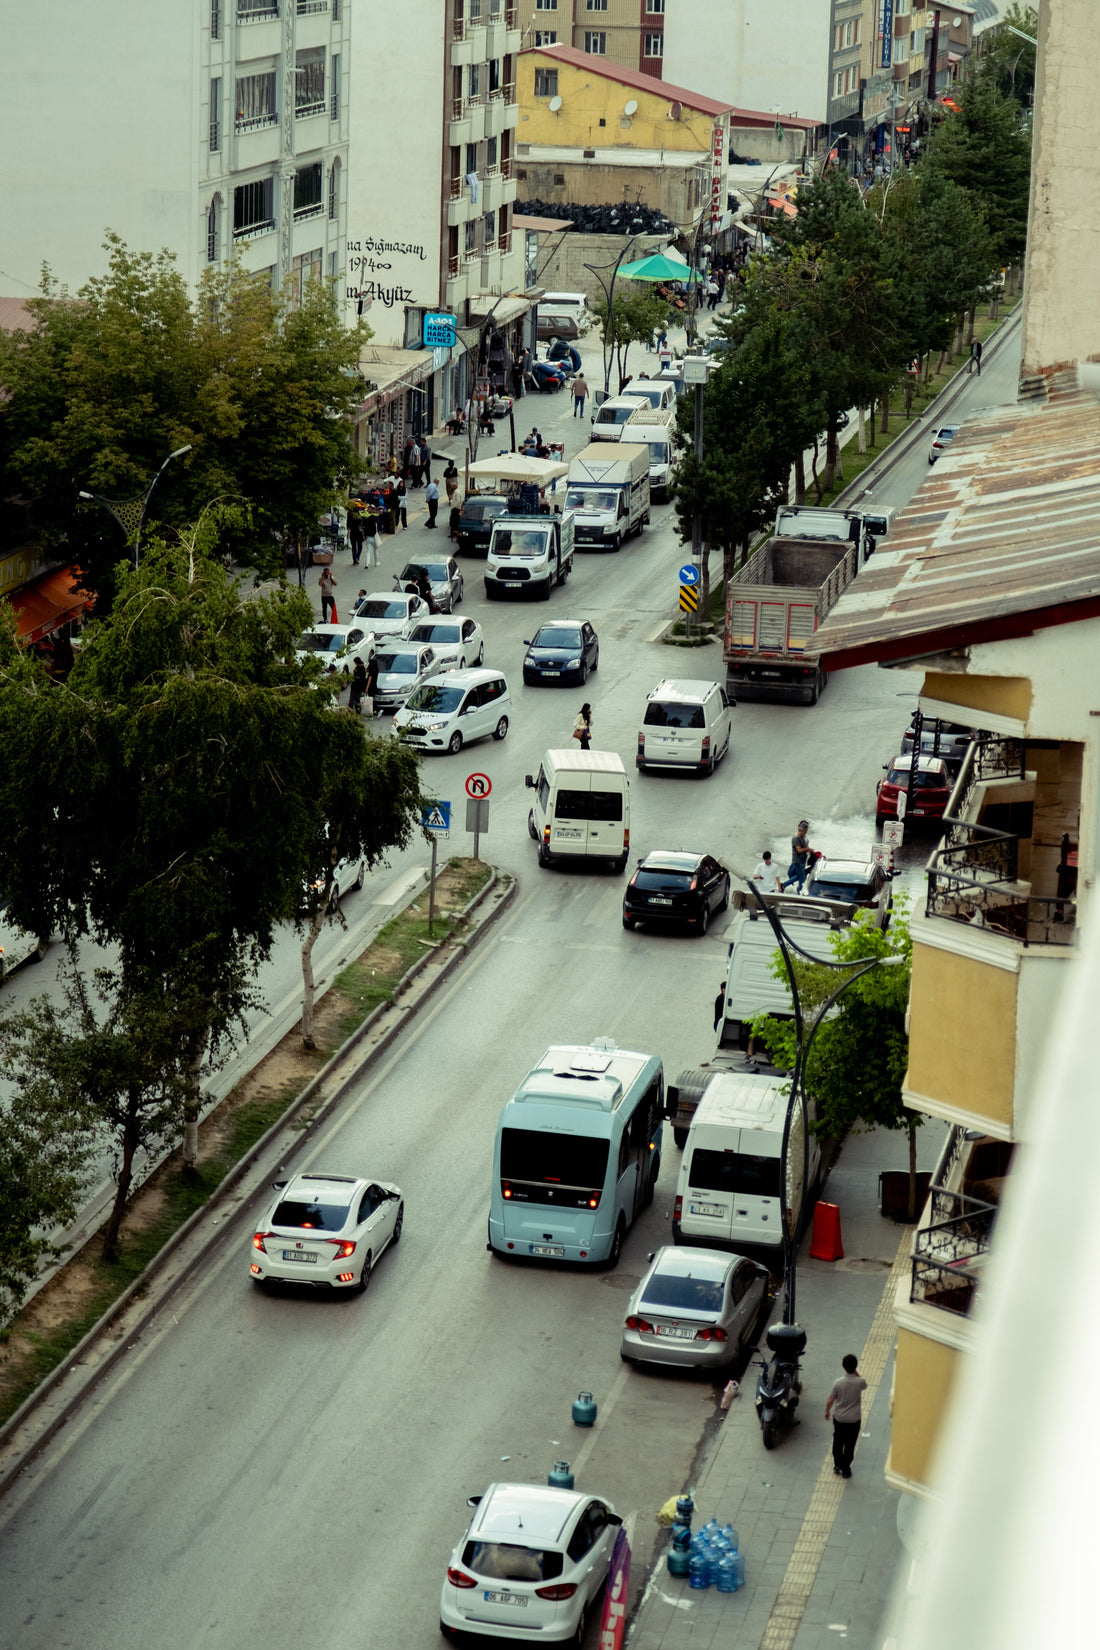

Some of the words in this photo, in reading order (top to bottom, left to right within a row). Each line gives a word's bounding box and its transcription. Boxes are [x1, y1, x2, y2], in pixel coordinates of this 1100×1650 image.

[714, 129, 723, 166] OTEL
[364, 281, 417, 308] Akyüz
[427, 324, 452, 332] HARCA
